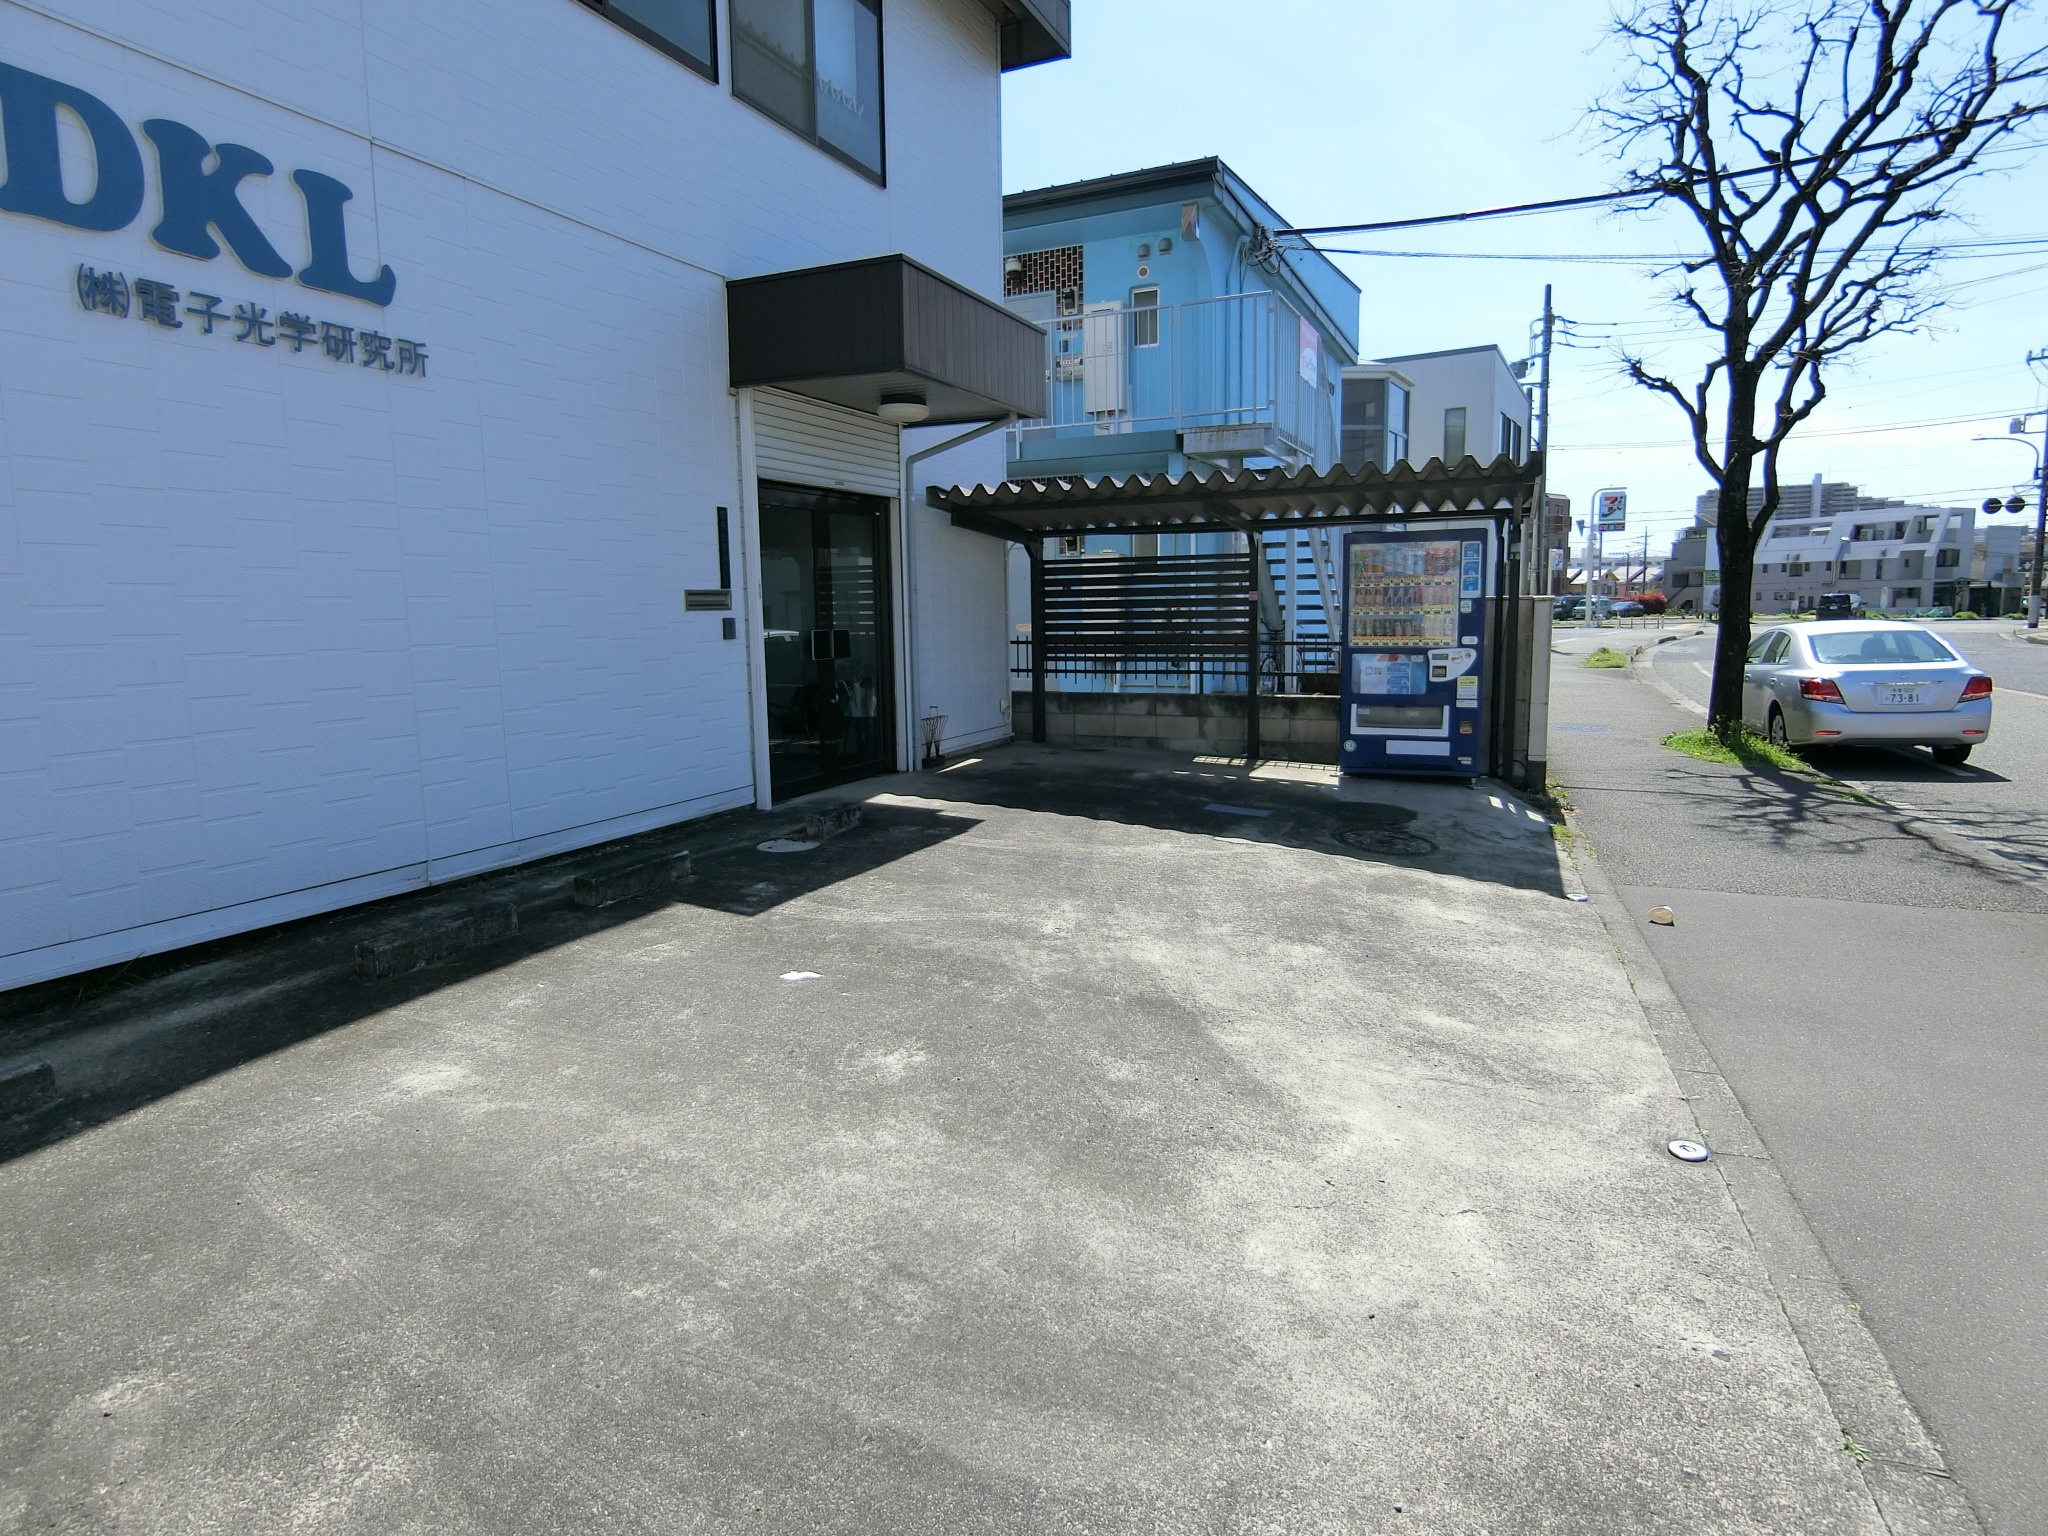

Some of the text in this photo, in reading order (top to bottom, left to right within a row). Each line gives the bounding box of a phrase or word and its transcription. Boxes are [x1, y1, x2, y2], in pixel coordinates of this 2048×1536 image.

[0, 61, 396, 307] DKL
[77, 262, 430, 378] (株)電子光学研究所
[1890, 693, 1919, 703] 73-81
